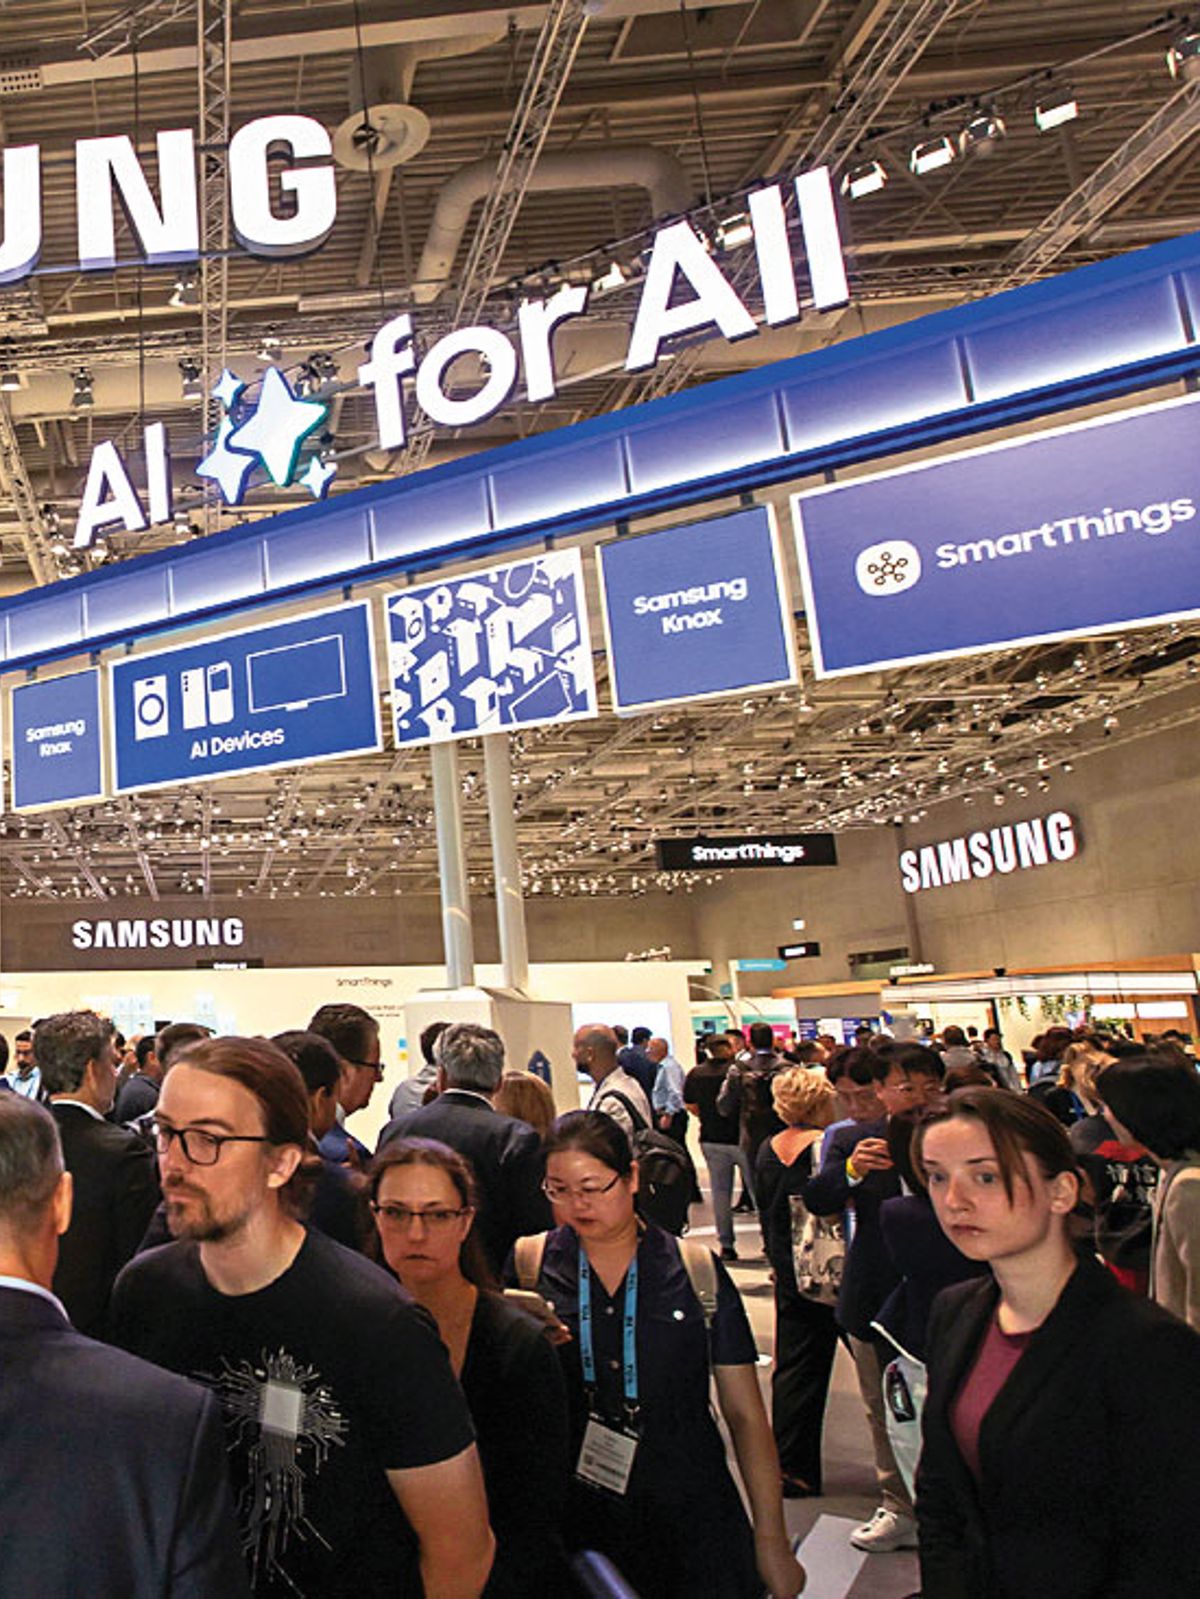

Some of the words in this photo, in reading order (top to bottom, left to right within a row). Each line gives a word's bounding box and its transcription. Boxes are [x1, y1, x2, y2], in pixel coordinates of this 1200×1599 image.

[74, 422, 173, 548] AI
[358, 283, 588, 451] for
[624, 166, 851, 372] All
[935, 498, 1197, 569] SmartThings
[632, 576, 748, 616] Samsung
[661, 606, 723, 636] Knox
[26, 717, 86, 743] Samsung
[190, 742, 209, 760] AI
[210, 727, 285, 757] Devices
[39, 739, 73, 757] Knox
[692, 842, 805, 864] SmartThings
[900, 811, 1078, 894] SAMSUNG
[72, 917, 245, 950] SAMSUNG
[336, 976, 394, 988] SmartThings
